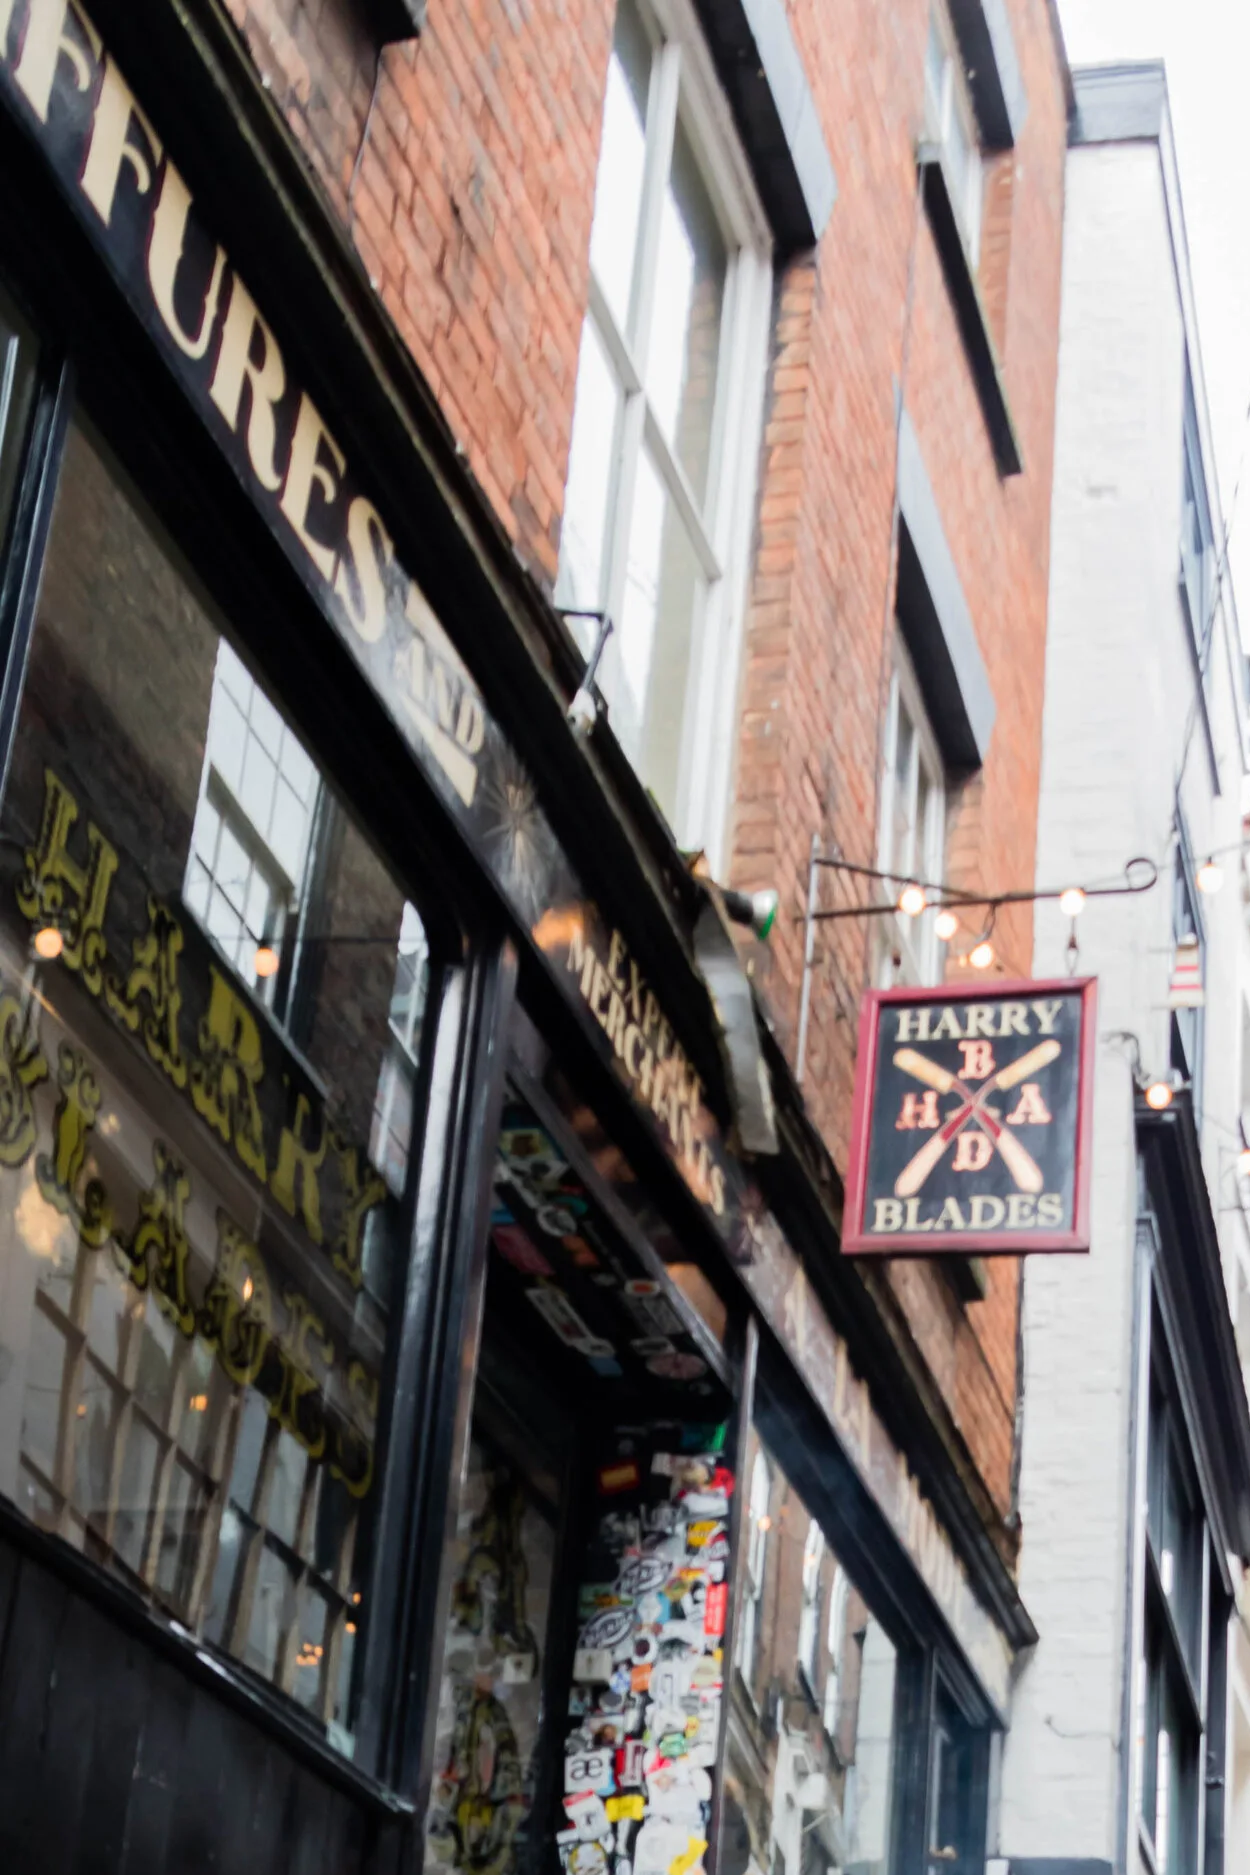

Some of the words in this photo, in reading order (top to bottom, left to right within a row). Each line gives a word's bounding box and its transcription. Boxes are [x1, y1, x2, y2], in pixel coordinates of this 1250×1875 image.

[0, 0, 395, 643] FFURES
[895, 1000, 1063, 1041] HARRY
[958, 1040, 995, 1079] B
[895, 1090, 940, 1130] H
[1006, 1084, 1051, 1124] A
[952, 1131, 993, 1171] D
[871, 1194, 1064, 1233] BLADES
